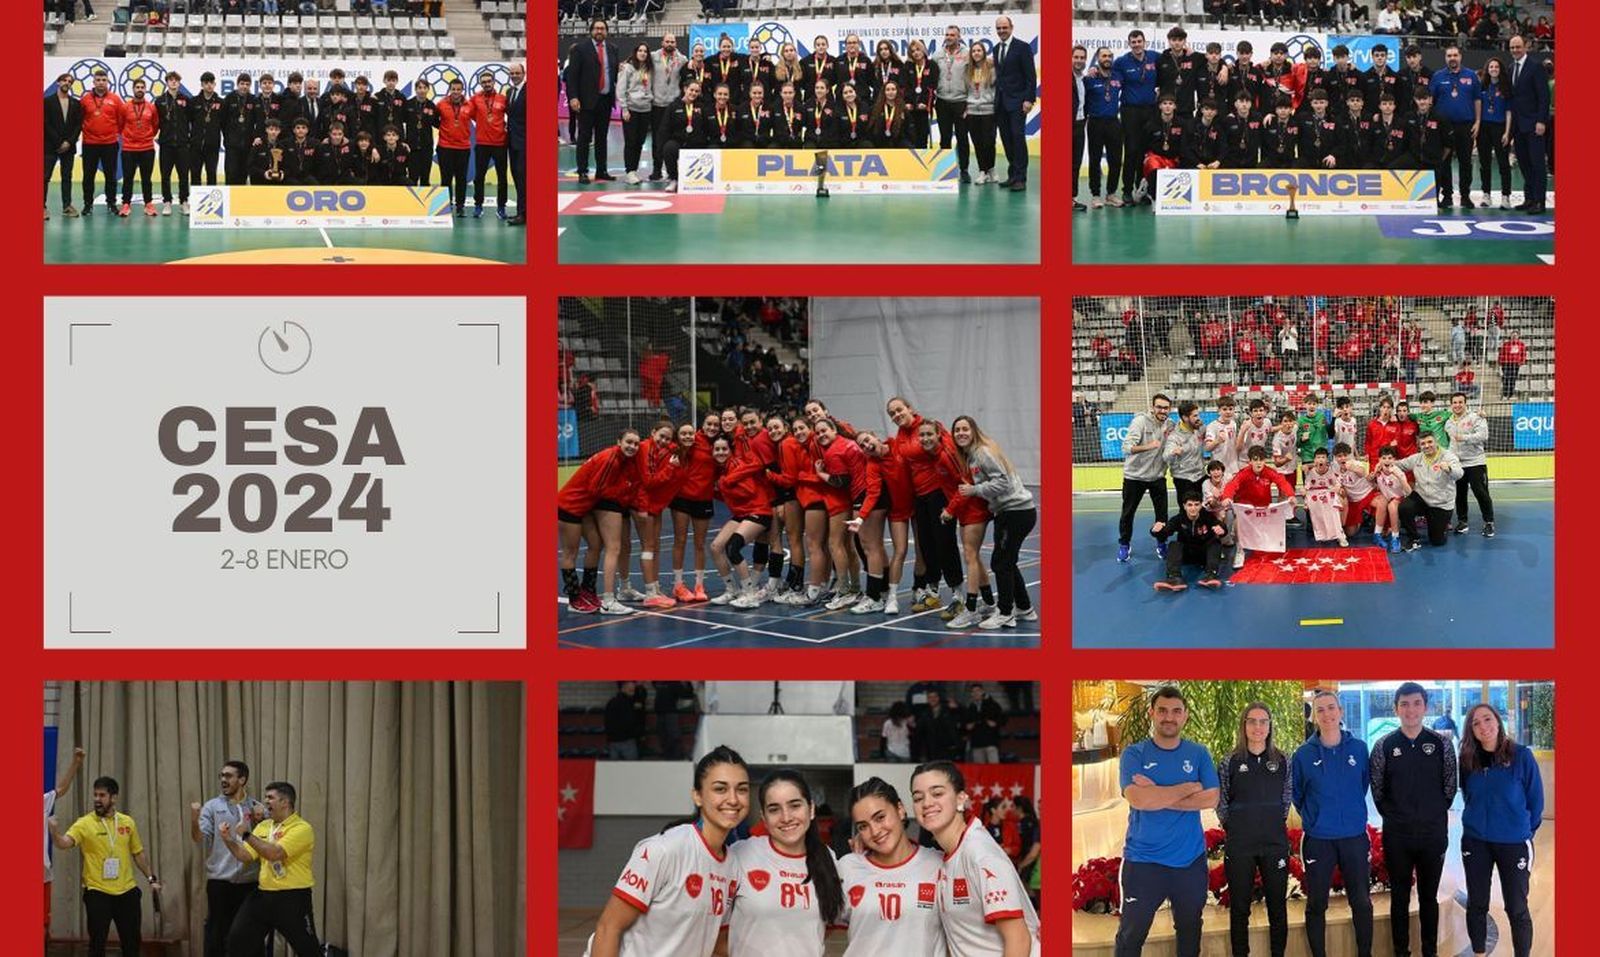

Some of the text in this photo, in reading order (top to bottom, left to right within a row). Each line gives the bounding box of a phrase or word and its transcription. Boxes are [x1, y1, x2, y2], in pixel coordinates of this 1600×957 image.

[757, 154, 889, 177] PLATA
[1211, 173, 1382, 196] BRONCE
[286, 190, 366, 211] ORO
[621, 869, 648, 892] AON
[780, 883, 810, 910] 84
[878, 893, 901, 920] 10
